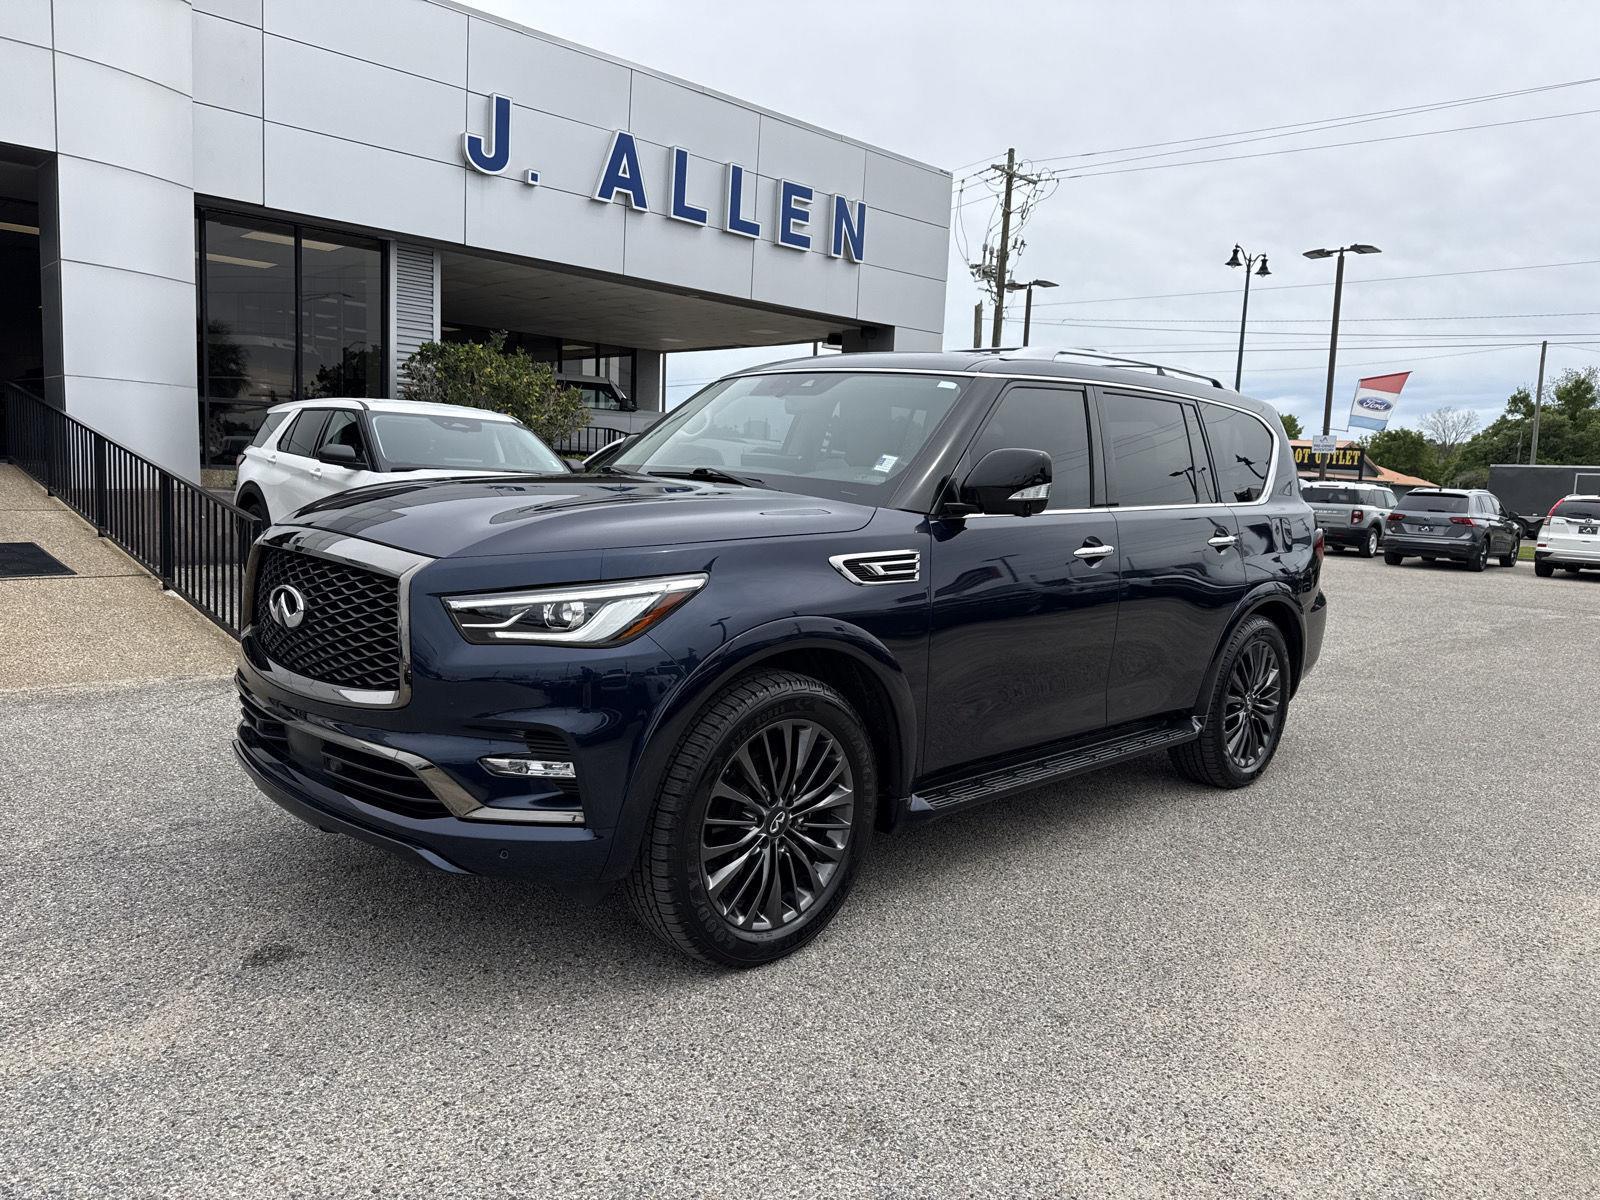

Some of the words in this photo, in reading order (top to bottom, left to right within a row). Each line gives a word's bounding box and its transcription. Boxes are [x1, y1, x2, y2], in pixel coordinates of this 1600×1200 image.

[462, 93, 542, 187] J.
[592, 129, 868, 264] ALLEN
[1363, 398, 1387, 410] Ford
